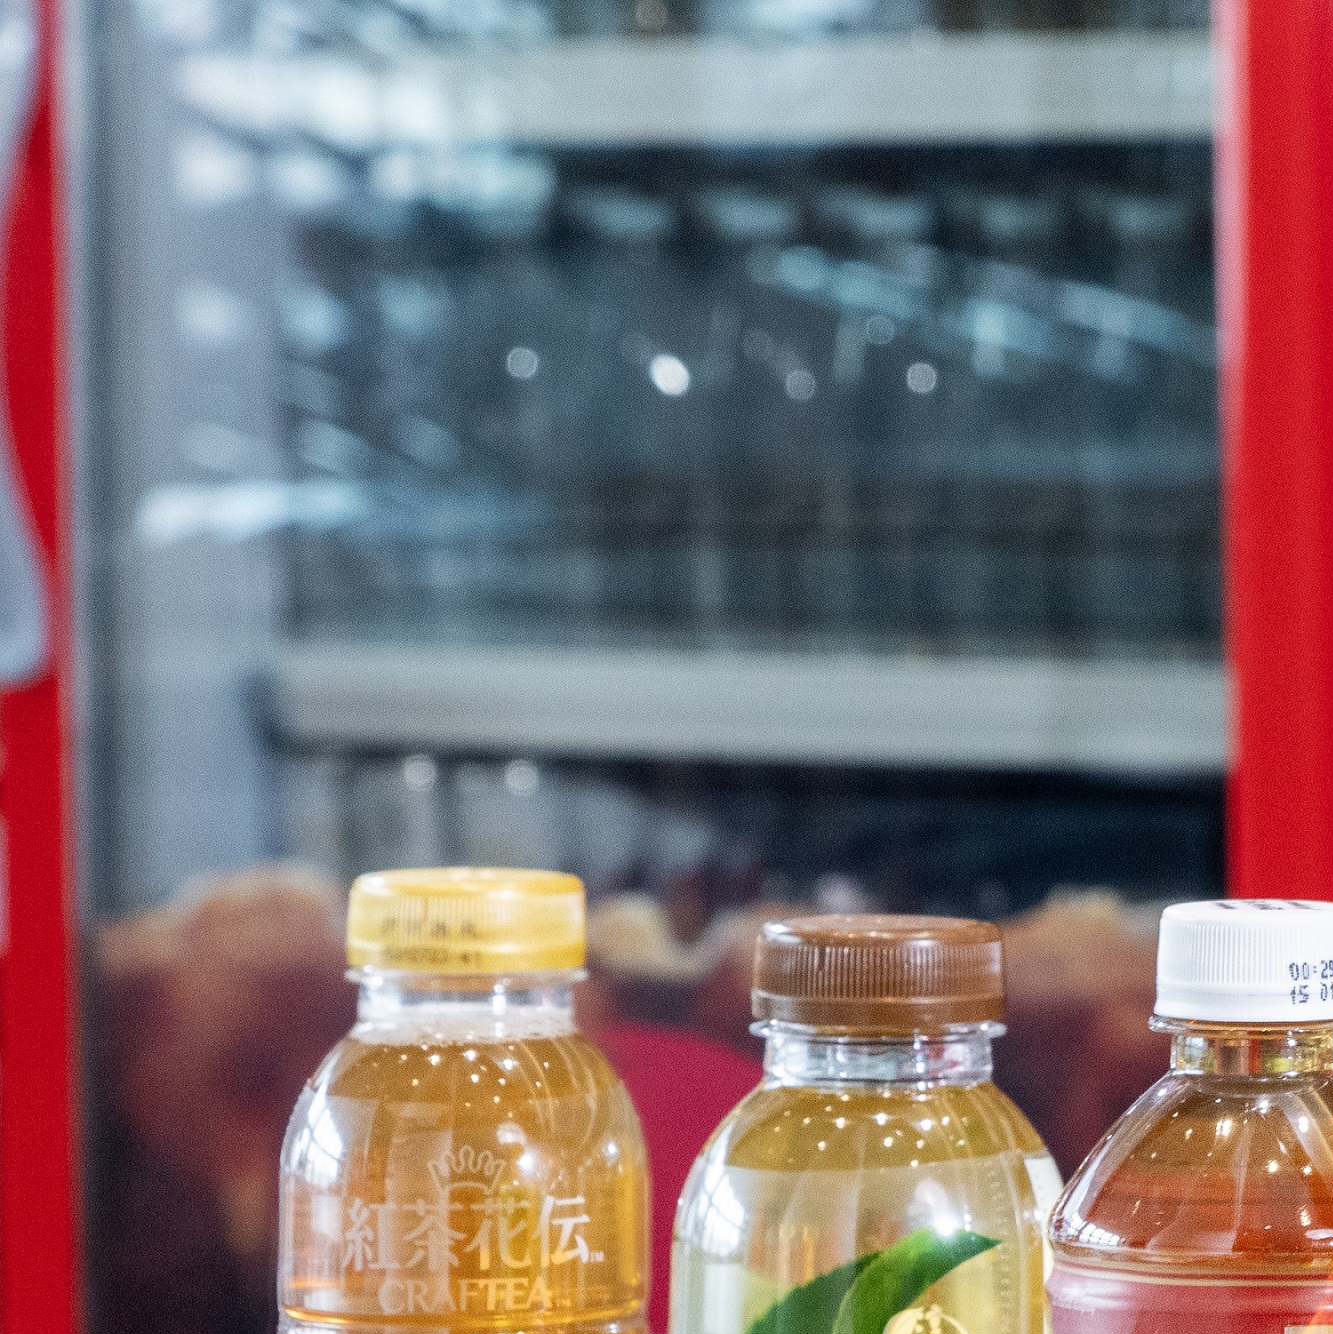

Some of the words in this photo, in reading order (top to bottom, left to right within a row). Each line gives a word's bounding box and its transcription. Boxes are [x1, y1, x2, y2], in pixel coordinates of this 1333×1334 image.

[342, 1195, 592, 1271] 紅茶花伝
[378, 1276, 553, 1315] CRAFTEA
